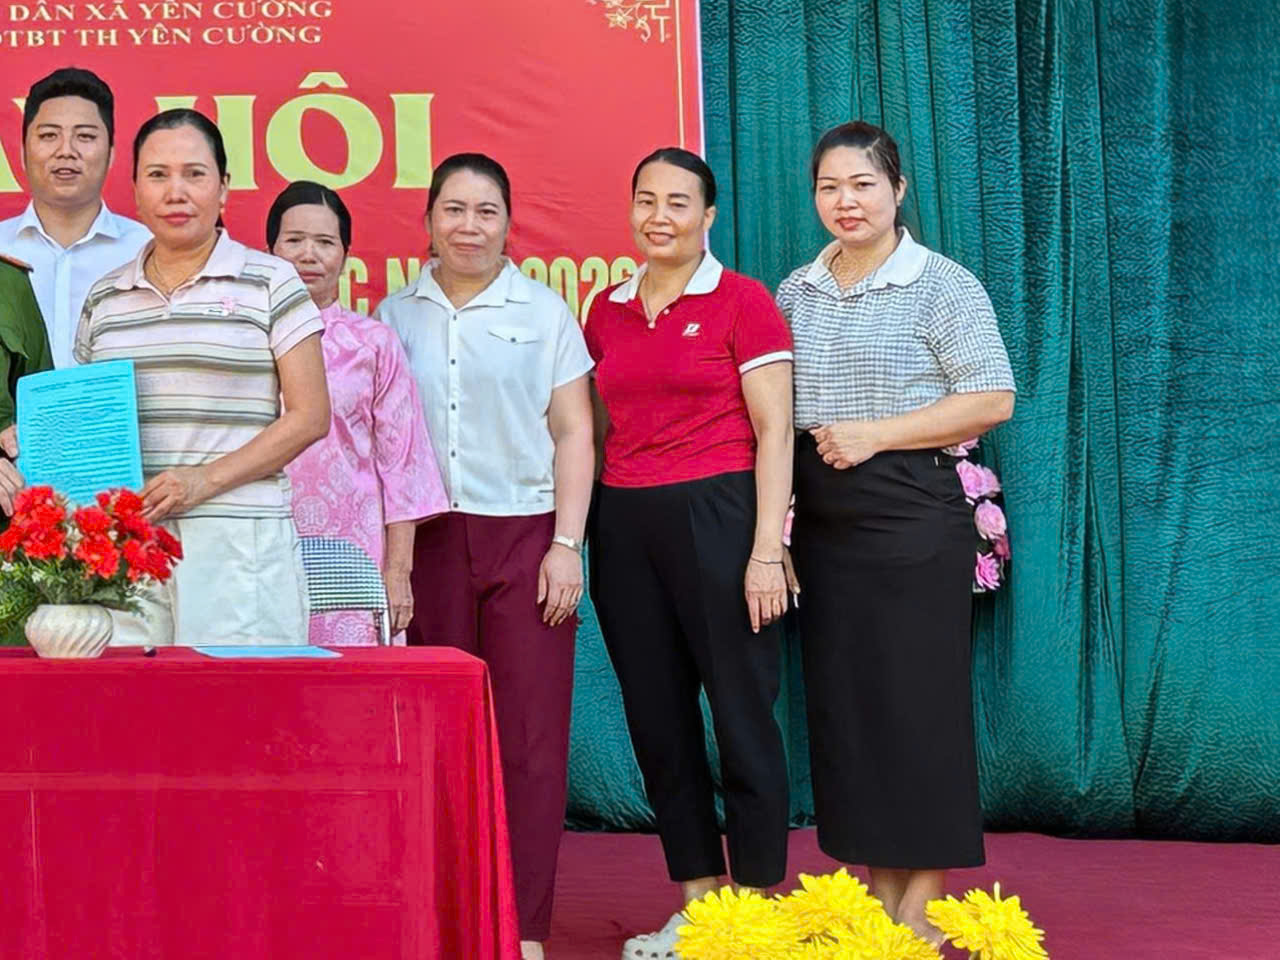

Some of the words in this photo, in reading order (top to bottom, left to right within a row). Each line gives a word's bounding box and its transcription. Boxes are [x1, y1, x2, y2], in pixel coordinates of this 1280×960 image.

[9, 0, 75, 22] DÂN
[85, 0, 128, 21] XÃ
[74, 28, 118, 47] TH
[128, 23, 191, 45] YÊN
[202, 22, 321, 44] CƯỜNG
